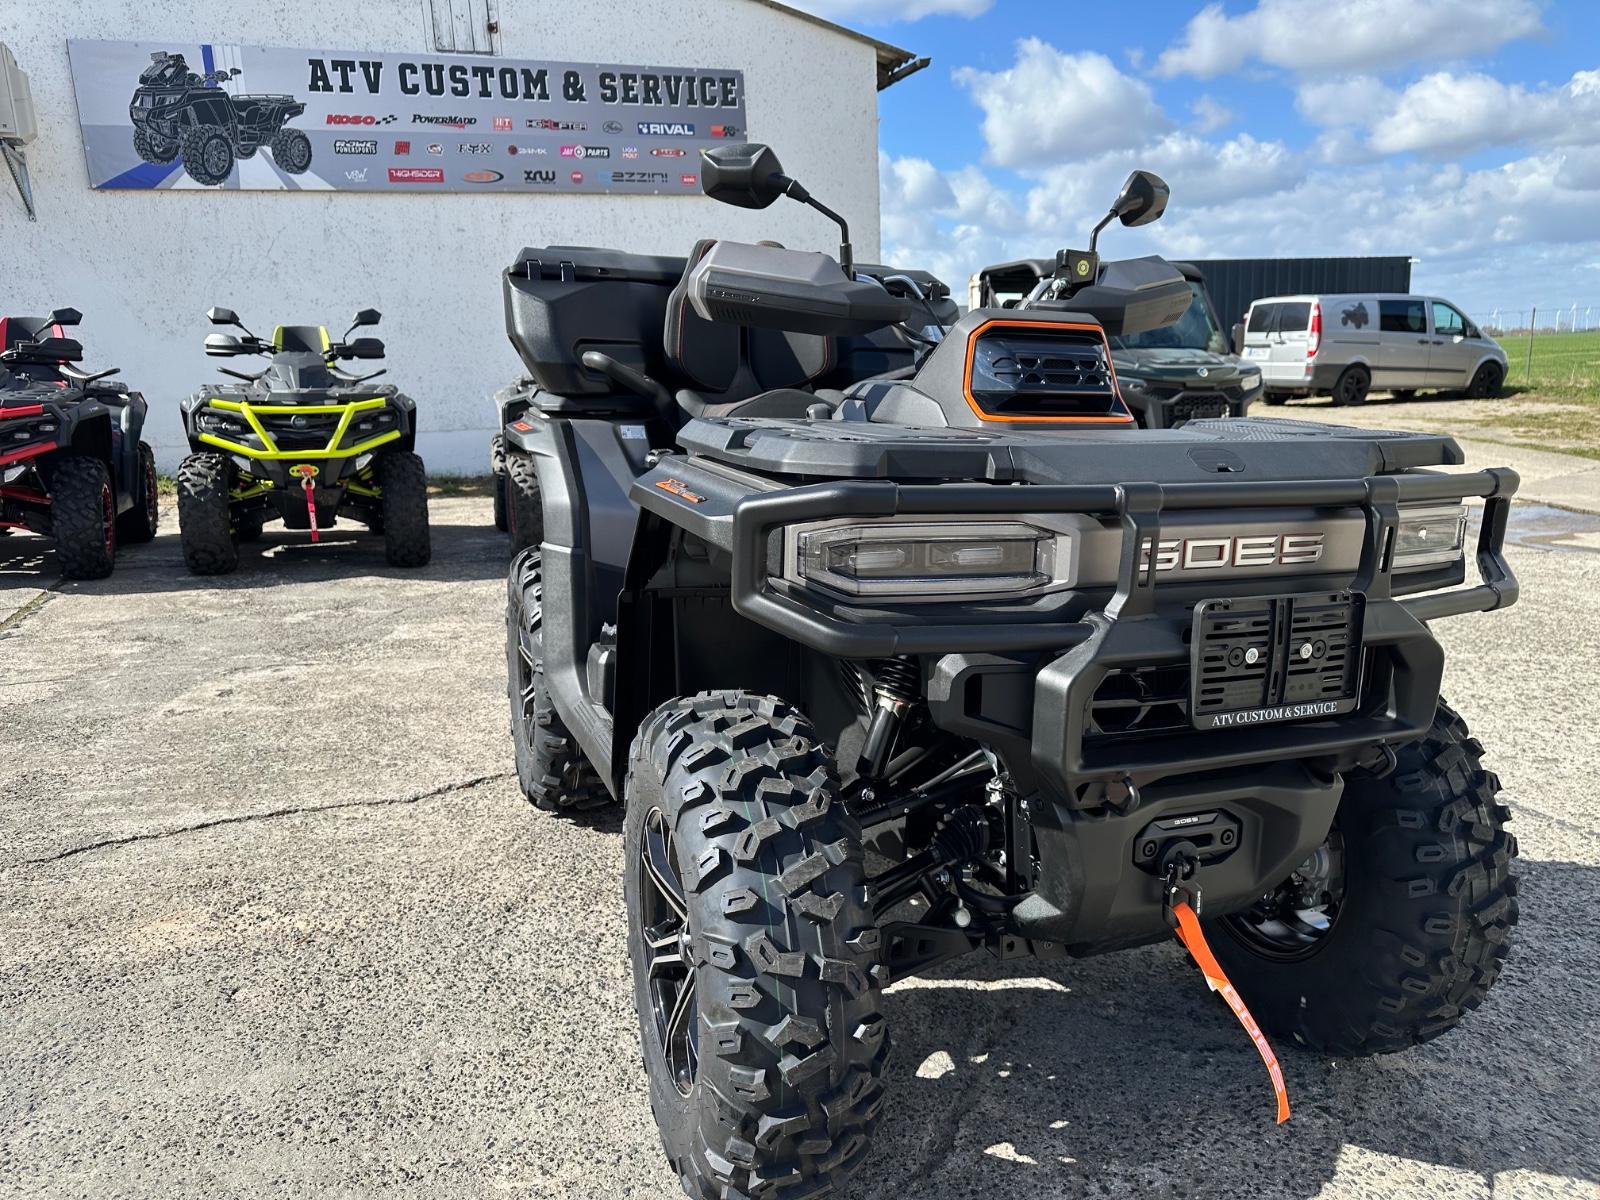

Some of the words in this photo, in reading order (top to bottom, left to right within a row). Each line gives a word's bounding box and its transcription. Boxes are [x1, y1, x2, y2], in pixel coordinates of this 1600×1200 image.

[308, 58, 383, 94] ATV
[398, 62, 551, 102] CUSTOM
[562, 70, 588, 103] &
[599, 72, 739, 109] SERVICE
[326, 114, 376, 126] KOSO
[650, 124, 694, 136] RIVAL
[335, 146, 377, 154] POWERSPORTS
[587, 148, 609, 157] PARTS
[1212, 713, 1235, 727] ATV
[1236, 707, 1283, 724] CUSTOM
[1284, 707, 1293, 718] &
[1294, 701, 1338, 717] SERVICE
